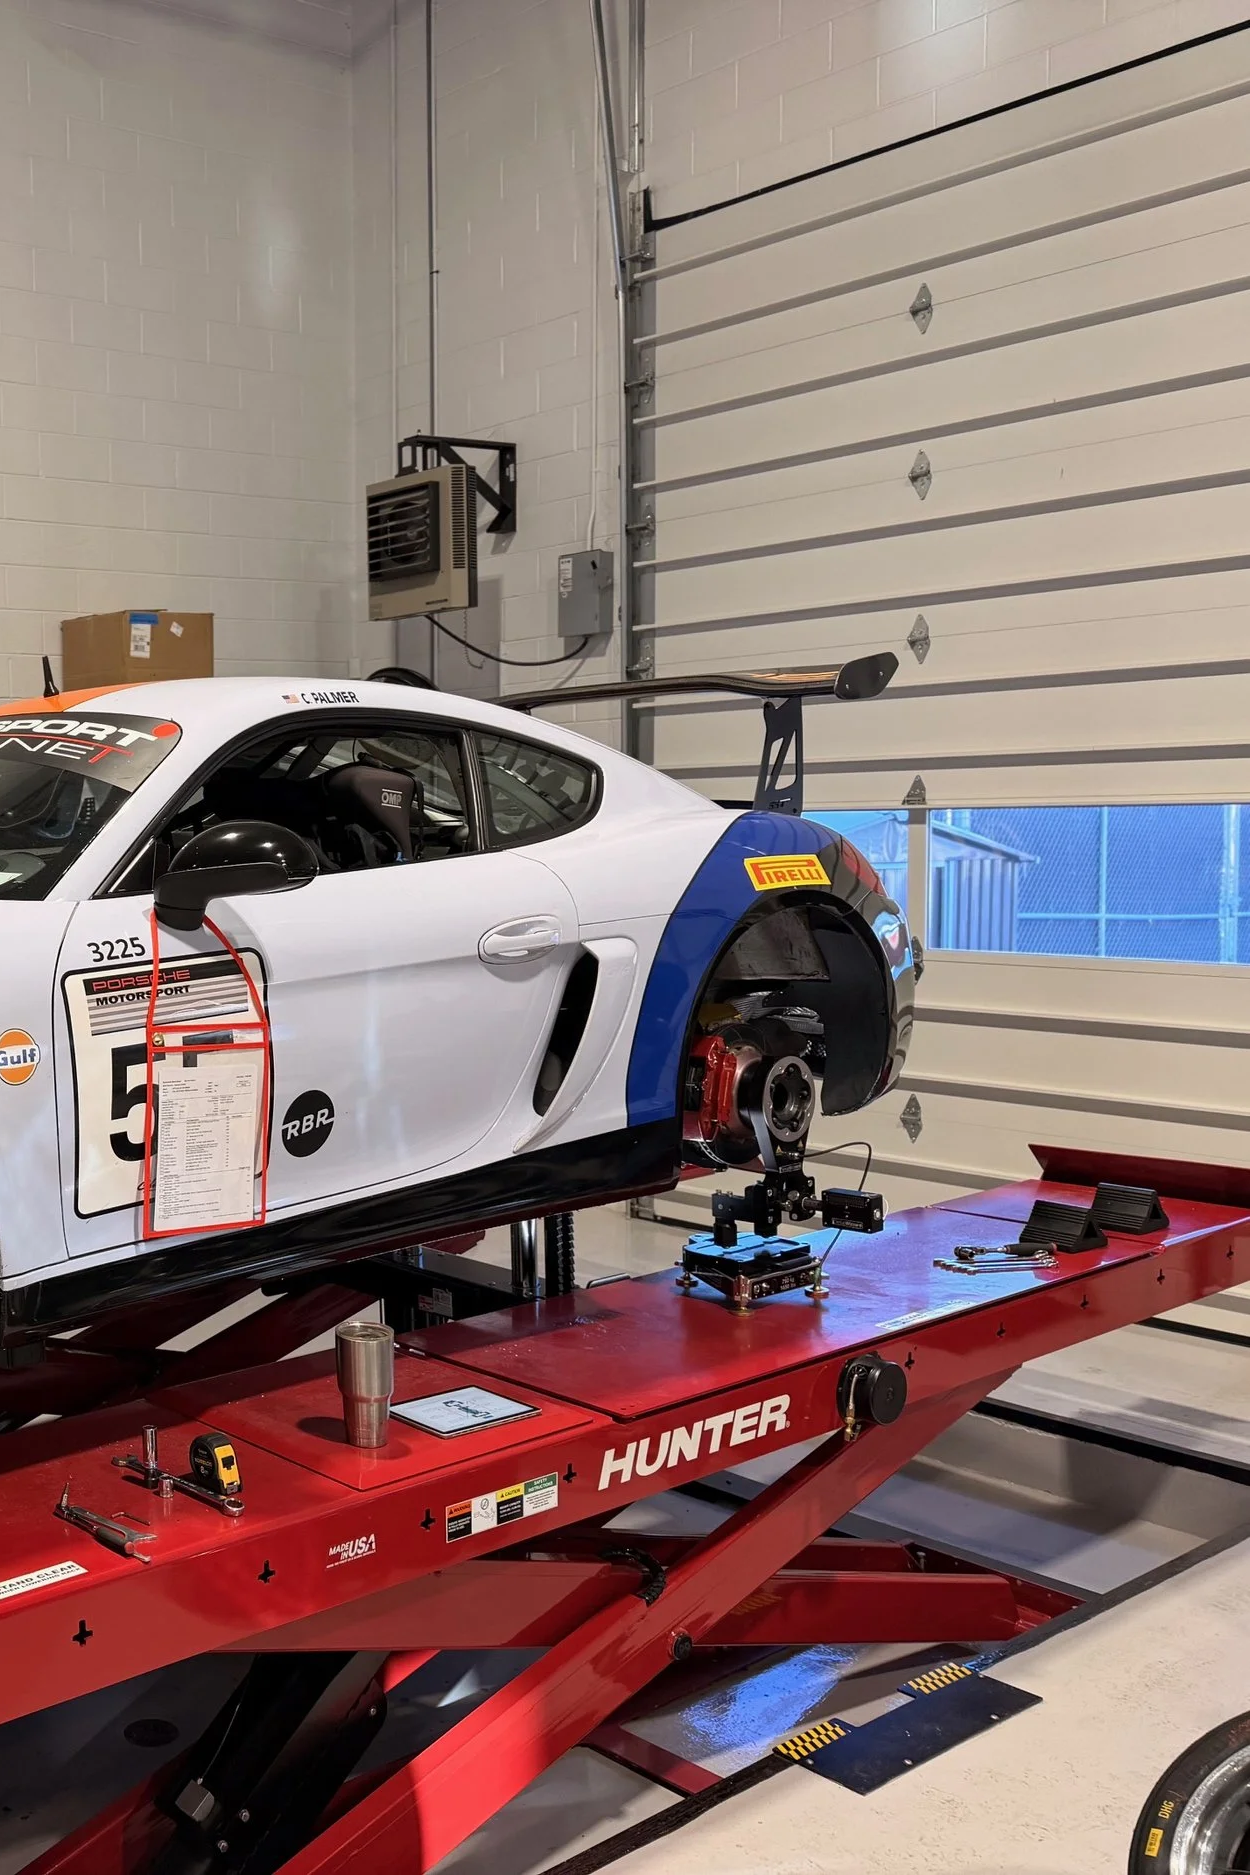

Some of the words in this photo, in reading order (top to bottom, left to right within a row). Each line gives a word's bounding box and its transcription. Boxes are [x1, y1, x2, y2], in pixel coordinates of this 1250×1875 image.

[301, 693, 312, 704] C.
[313, 691, 360, 704] PALMER
[381, 791, 402, 806] OMP
[750, 859, 823, 886] PIRELLI
[86, 936, 146, 963] 3225
[92, 969, 191, 992] PORSCHE
[95, 985, 191, 1007] MOTORSPORT
[285, 1108, 331, 1140] RBR
[598, 1394, 791, 1491] HUNTER
[504, 1487, 521, 1498] CAUTION
[528, 1481, 554, 1493] INSTRUCTIONS
[329, 1541, 351, 1557] MADE
[340, 1550, 350, 1561] IN
[349, 1533, 376, 1557] USA
[36, 1564, 77, 1579] CLEAR
[1158, 1800, 1175, 1819] DHG
